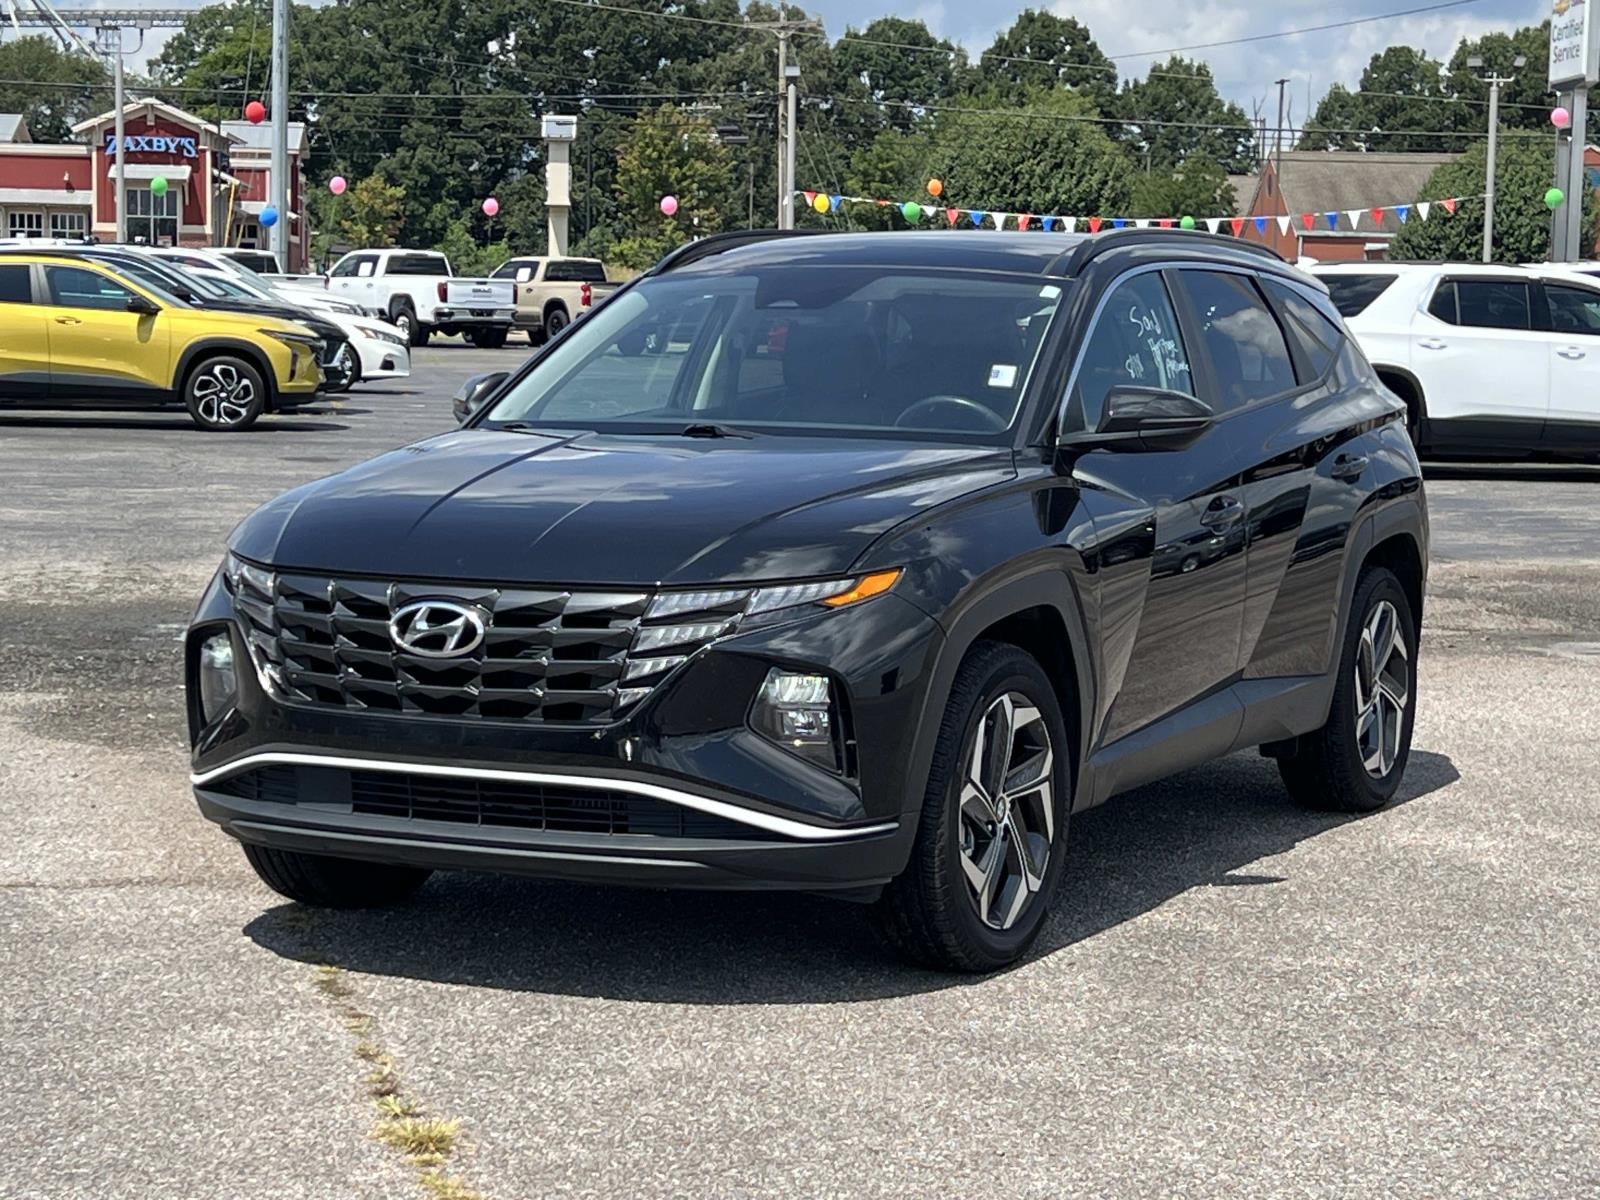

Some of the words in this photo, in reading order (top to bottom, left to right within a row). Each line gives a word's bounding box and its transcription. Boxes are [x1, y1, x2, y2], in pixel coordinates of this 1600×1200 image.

[1553, 18, 1583, 42] Certified
[1553, 44, 1580, 64] Service
[105, 134, 197, 158] ZAXBY'S
